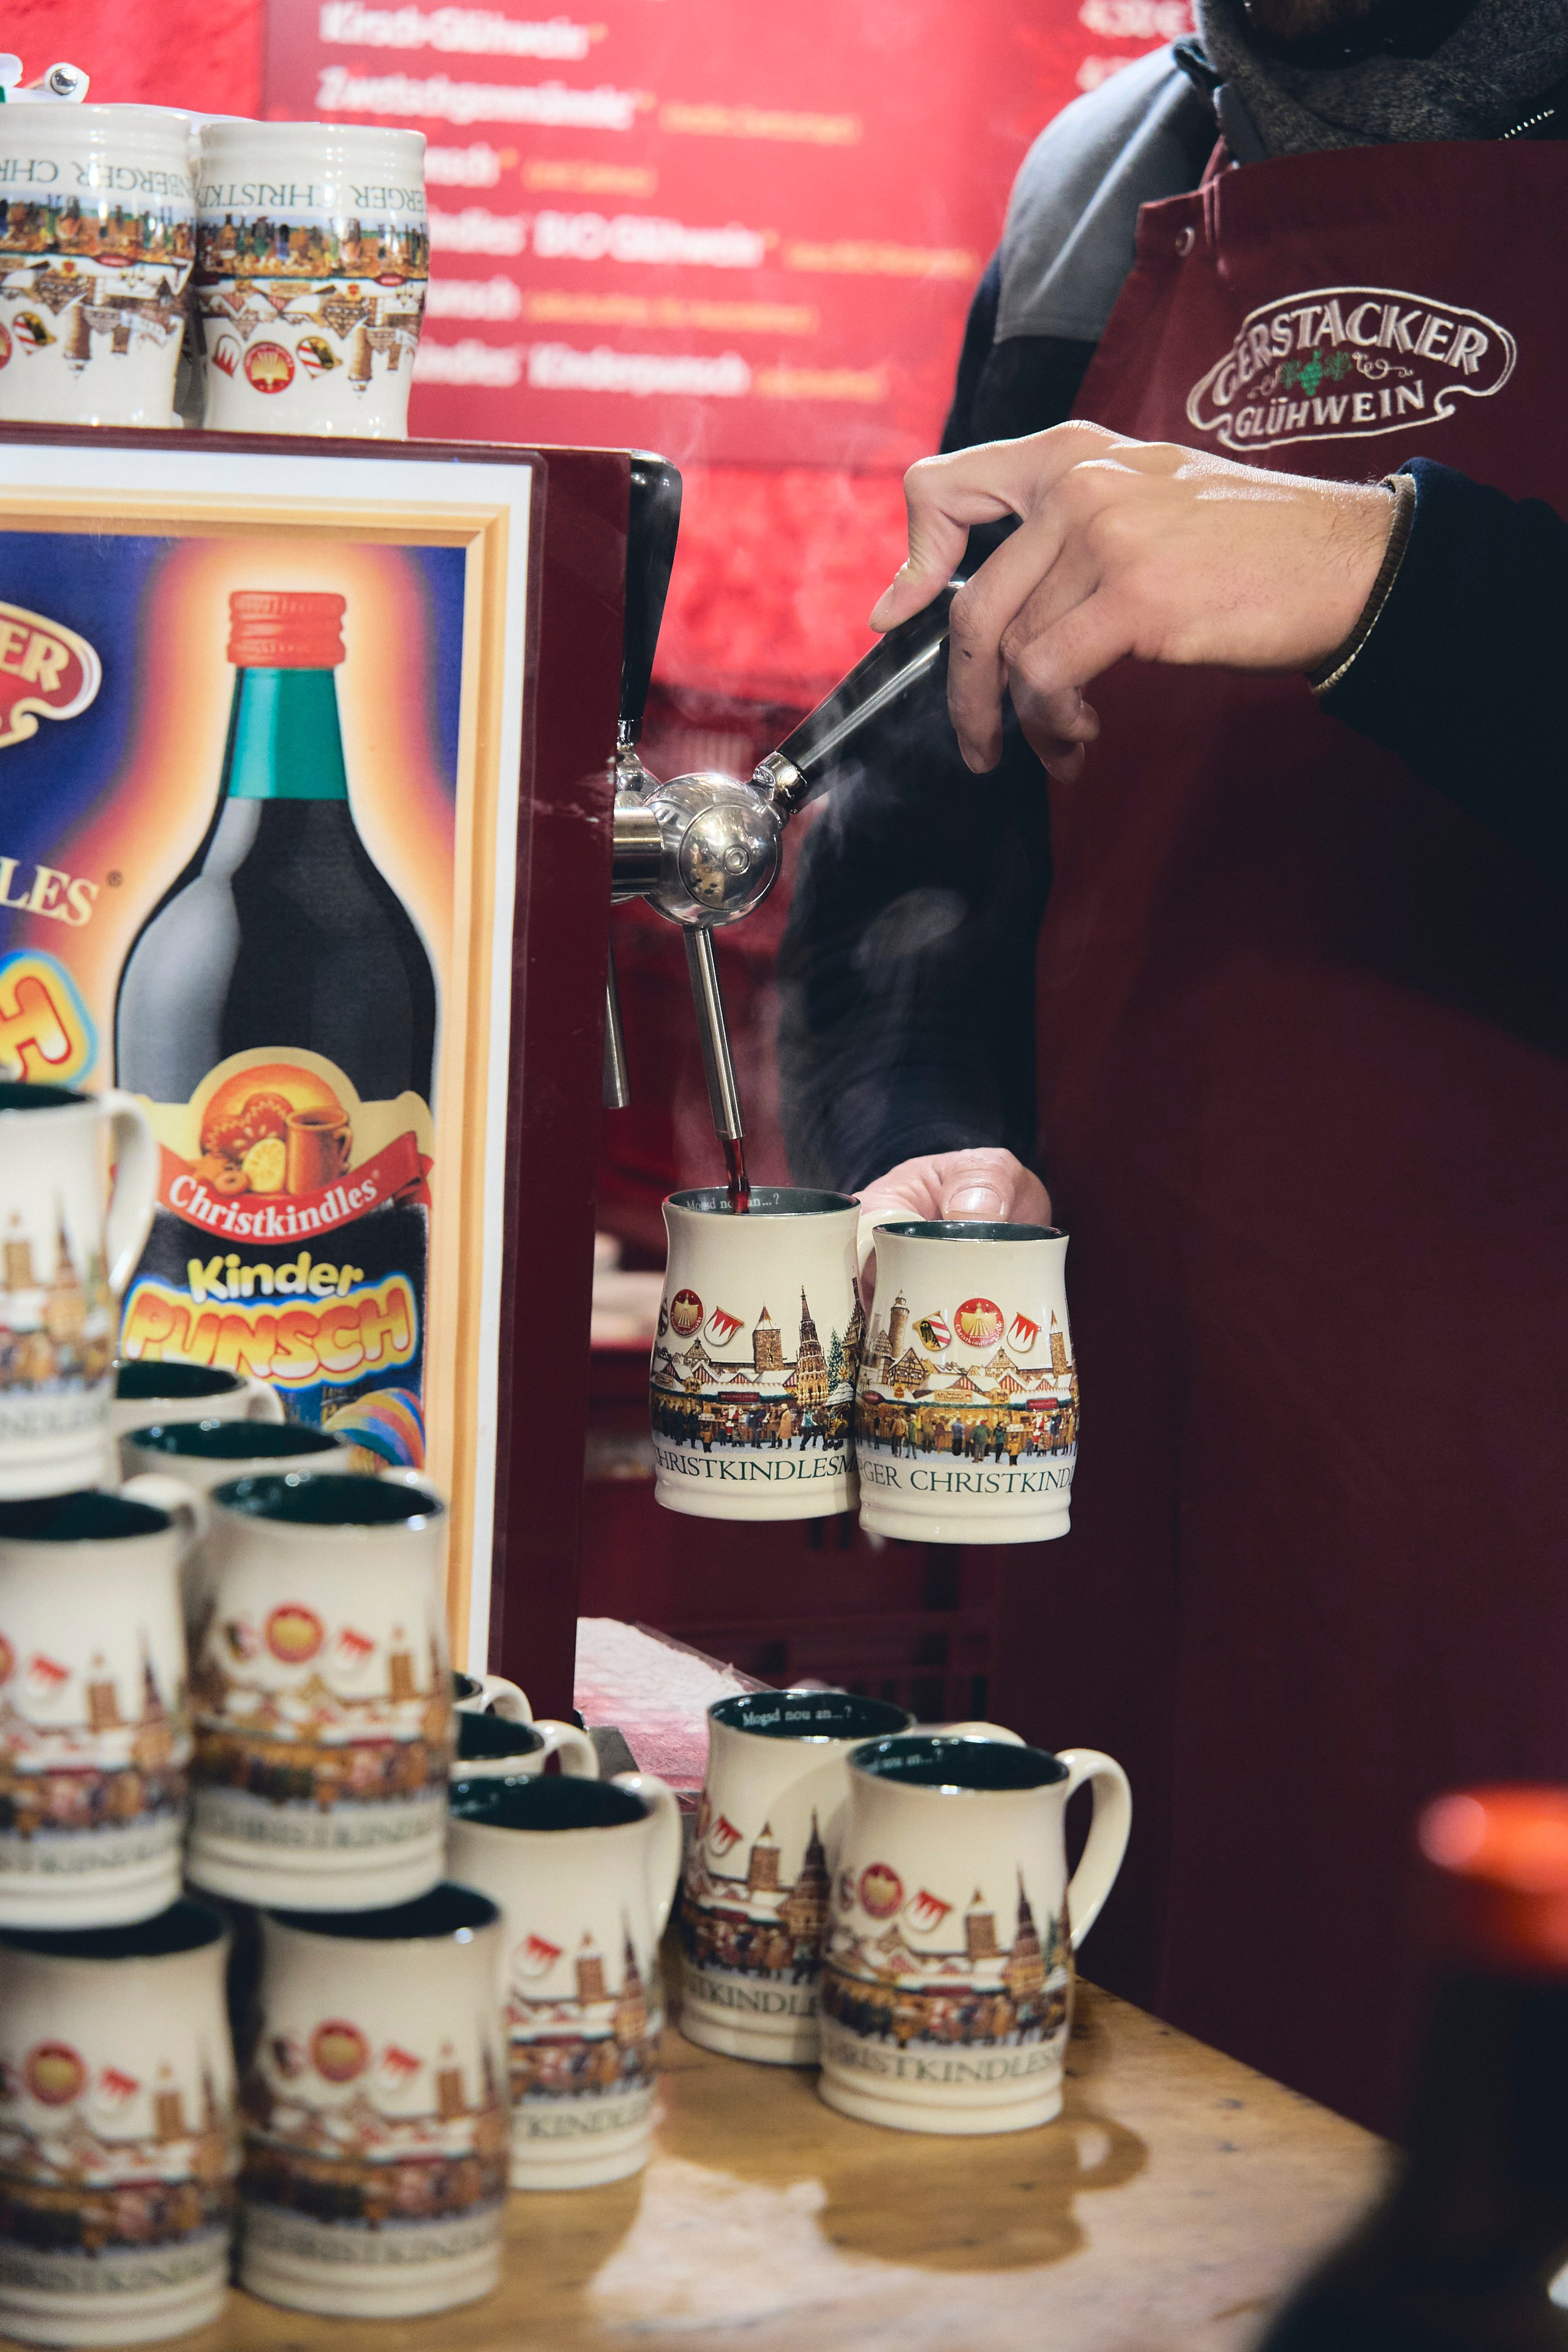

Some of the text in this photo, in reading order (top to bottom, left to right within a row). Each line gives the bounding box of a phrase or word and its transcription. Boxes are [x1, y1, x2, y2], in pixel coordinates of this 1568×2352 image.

[1212, 298, 1489, 407] GERSTACKER
[1235, 380, 1425, 438] GLÜHWEIN
[168, 1174, 378, 1239] Christkindles
[187, 1251, 364, 1304] Kinder
[126, 1286, 411, 1380] PUNSCH
